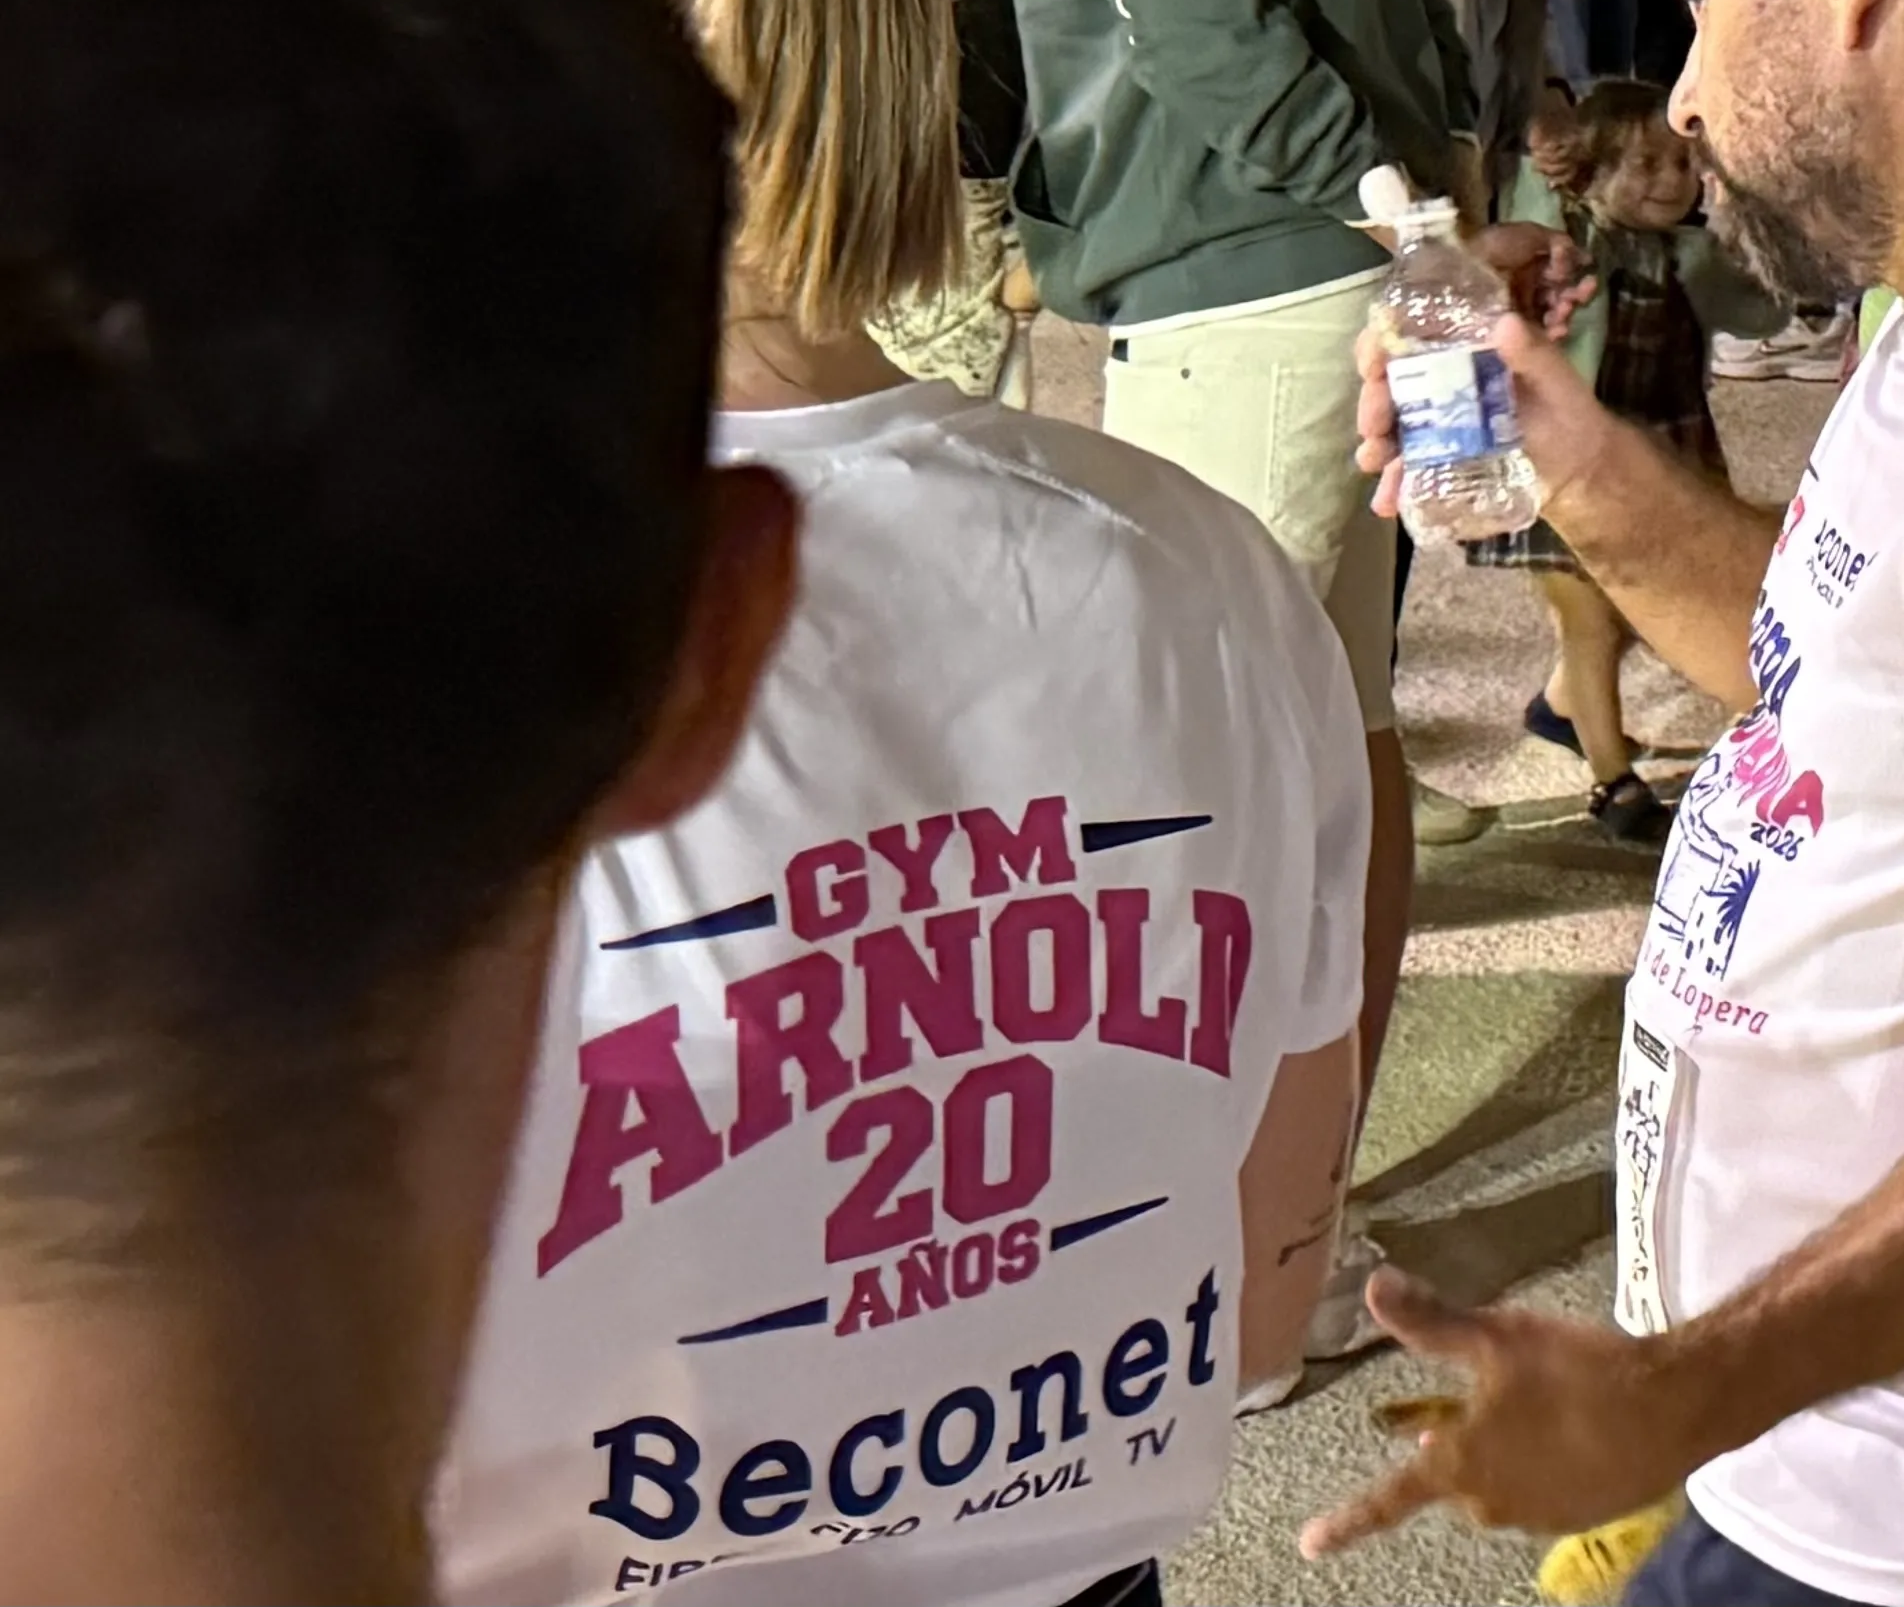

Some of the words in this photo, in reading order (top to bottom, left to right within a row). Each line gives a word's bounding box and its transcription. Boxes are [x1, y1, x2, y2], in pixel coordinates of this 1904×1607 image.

[785, 794, 1076, 944] GYM
[1749, 820, 1806, 863] 2026
[1671, 966, 1772, 1037] Lopera
[536, 887, 1253, 1280] ARNOLD
[824, 1052, 1054, 1264] 20
[833, 1216, 1042, 1339] AÑOS
[588, 1266, 1221, 1541] Beconet
[953, 1457, 1094, 1523] MÓVIL
[1126, 1417, 1176, 1462] TV
